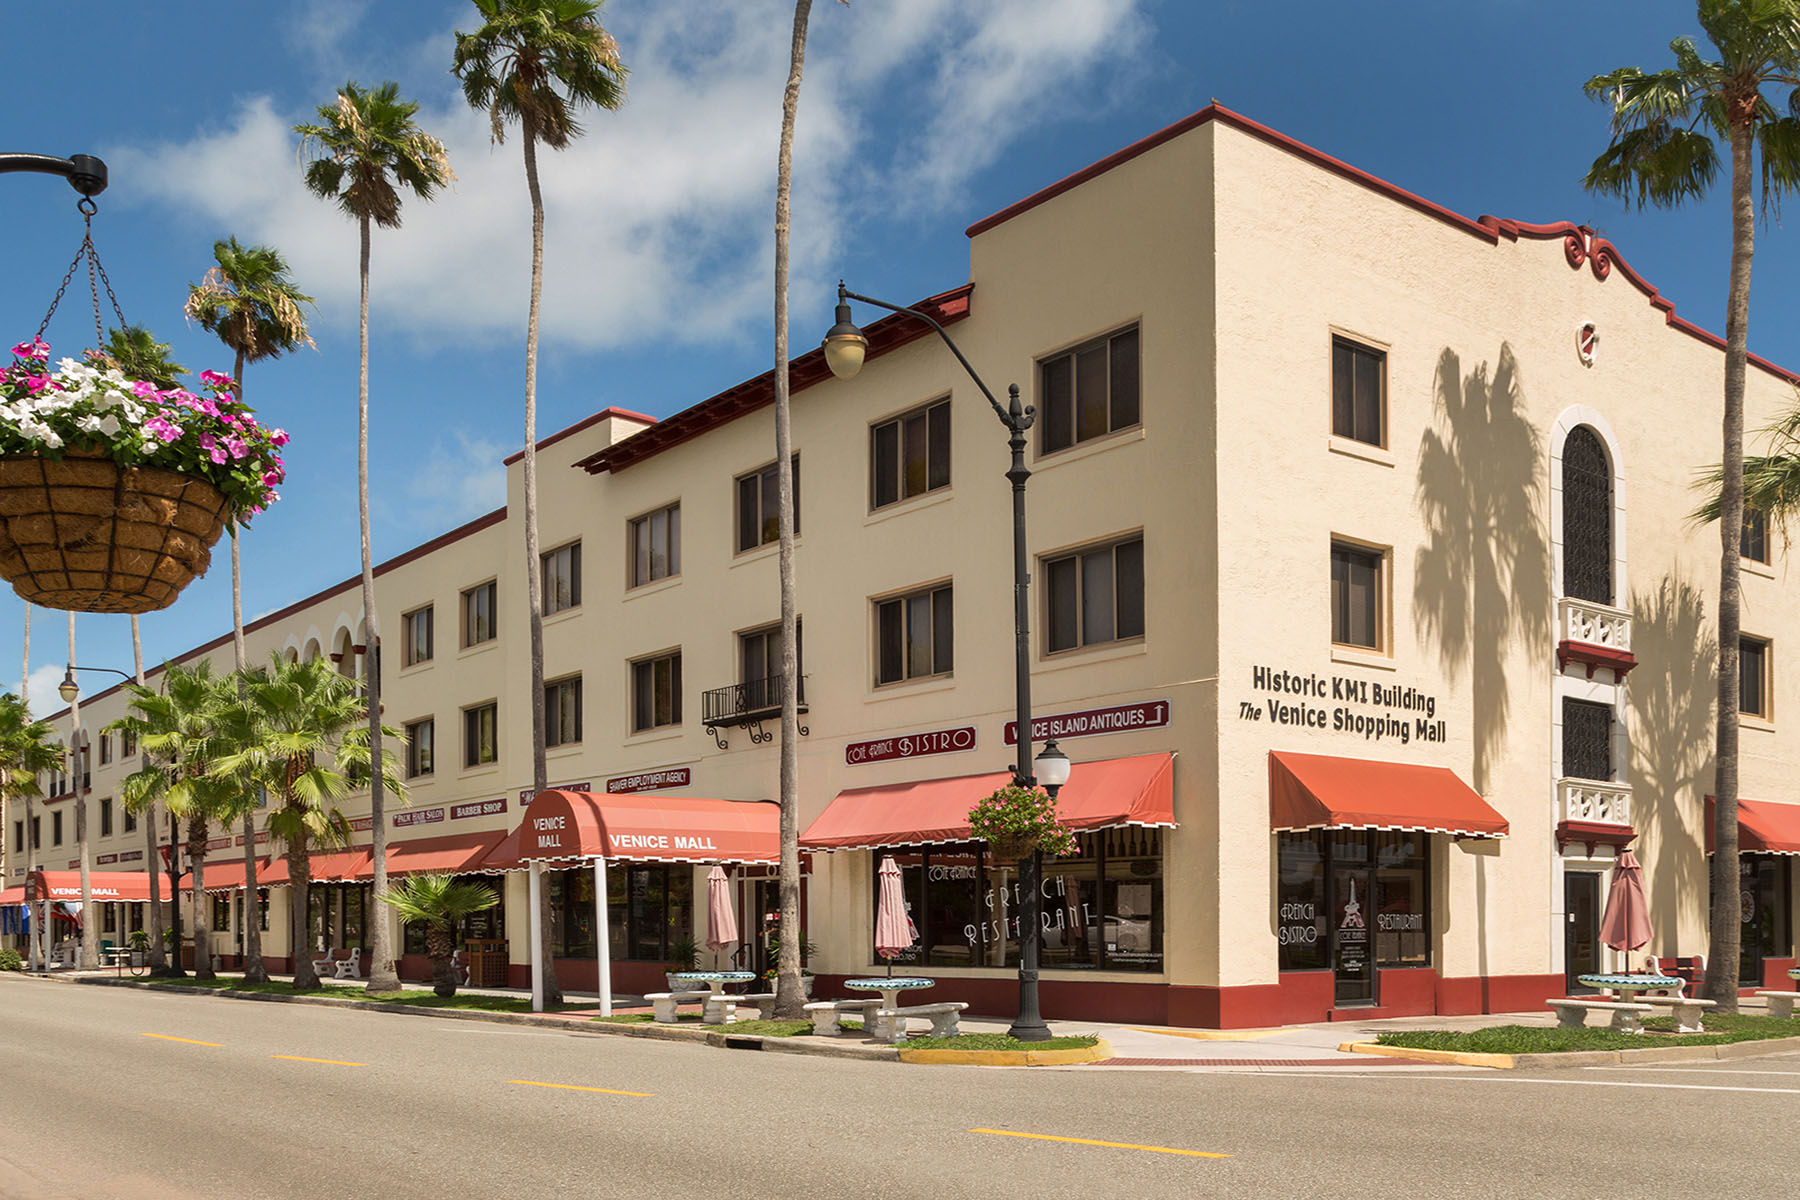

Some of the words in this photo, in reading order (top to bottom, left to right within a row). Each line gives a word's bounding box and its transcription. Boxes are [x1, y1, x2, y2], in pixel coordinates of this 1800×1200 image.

[1253, 665, 1327, 698] Historic
[1332, 677, 1368, 704] KMI
[1373, 683, 1435, 718] Building
[1012, 721, 1048, 740] VICE
[1050, 716, 1088, 735] ISLAND
[1090, 709, 1145, 730] ANTIQUES
[1239, 701, 1263, 721] The
[1267, 699, 1327, 728] Venice
[1333, 708, 1410, 744] Shopping
[1416, 718, 1446, 743] Mall
[898, 729, 971, 756] BISTRO
[609, 779, 628, 793] SHAVER
[628, 772, 666, 788] EMPLOYMENT
[666, 771, 686, 783] AGENCY
[425, 809, 443, 820] SALON
[456, 805, 481, 817] BARBER
[482, 802, 503, 814] SHOP
[533, 816, 565, 831] VENICE
[538, 834, 562, 848] MALL
[609, 834, 669, 849] VENICE
[674, 836, 717, 850] MALL
[51, 887, 82, 895] VENIC
[91, 887, 119, 895] MALL
[985, 875, 1065, 912] FRECH
[1280, 903, 1314, 921] FRENCH
[1377, 913, 1423, 931] RESTAURANT
[1279, 925, 1318, 945] BISTRO
